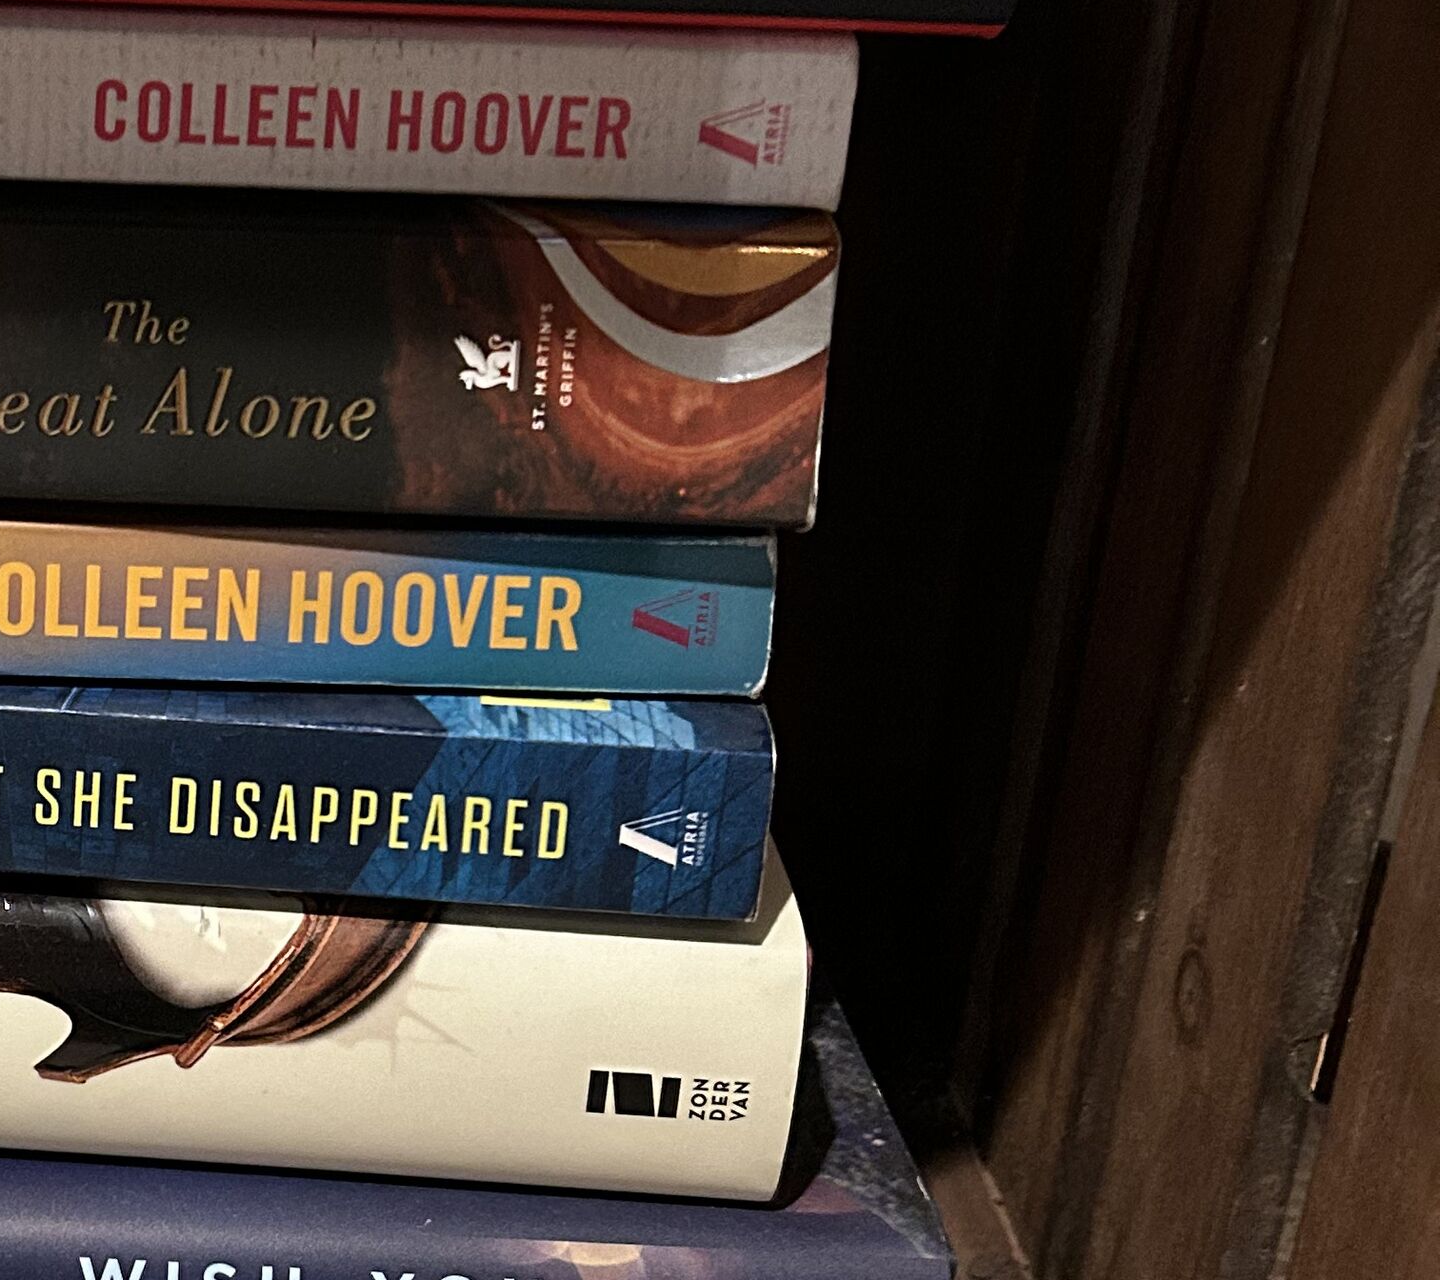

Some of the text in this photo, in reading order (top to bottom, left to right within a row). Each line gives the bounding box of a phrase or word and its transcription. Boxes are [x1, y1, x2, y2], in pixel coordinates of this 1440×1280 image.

[93, 79, 632, 160] COLLEEN HOOVER
[763, 104, 783, 165] ATRIA
[102, 301, 190, 346] The
[531, 303, 554, 431] ST. MARTIN'S
[559, 328, 577, 407] GRIFFIN
[140, 366, 378, 442] Alone
[288, 570, 582, 652] HOOVER
[695, 591, 711, 647] ATRIA
[35, 768, 136, 830] SHE
[170, 778, 569, 860] DISAPPEARED
[681, 811, 700, 866] ATRIA
[688, 1078, 709, 1120] ZON
[709, 1080, 730, 1121] DER
[729, 1081, 751, 1121] VAN
